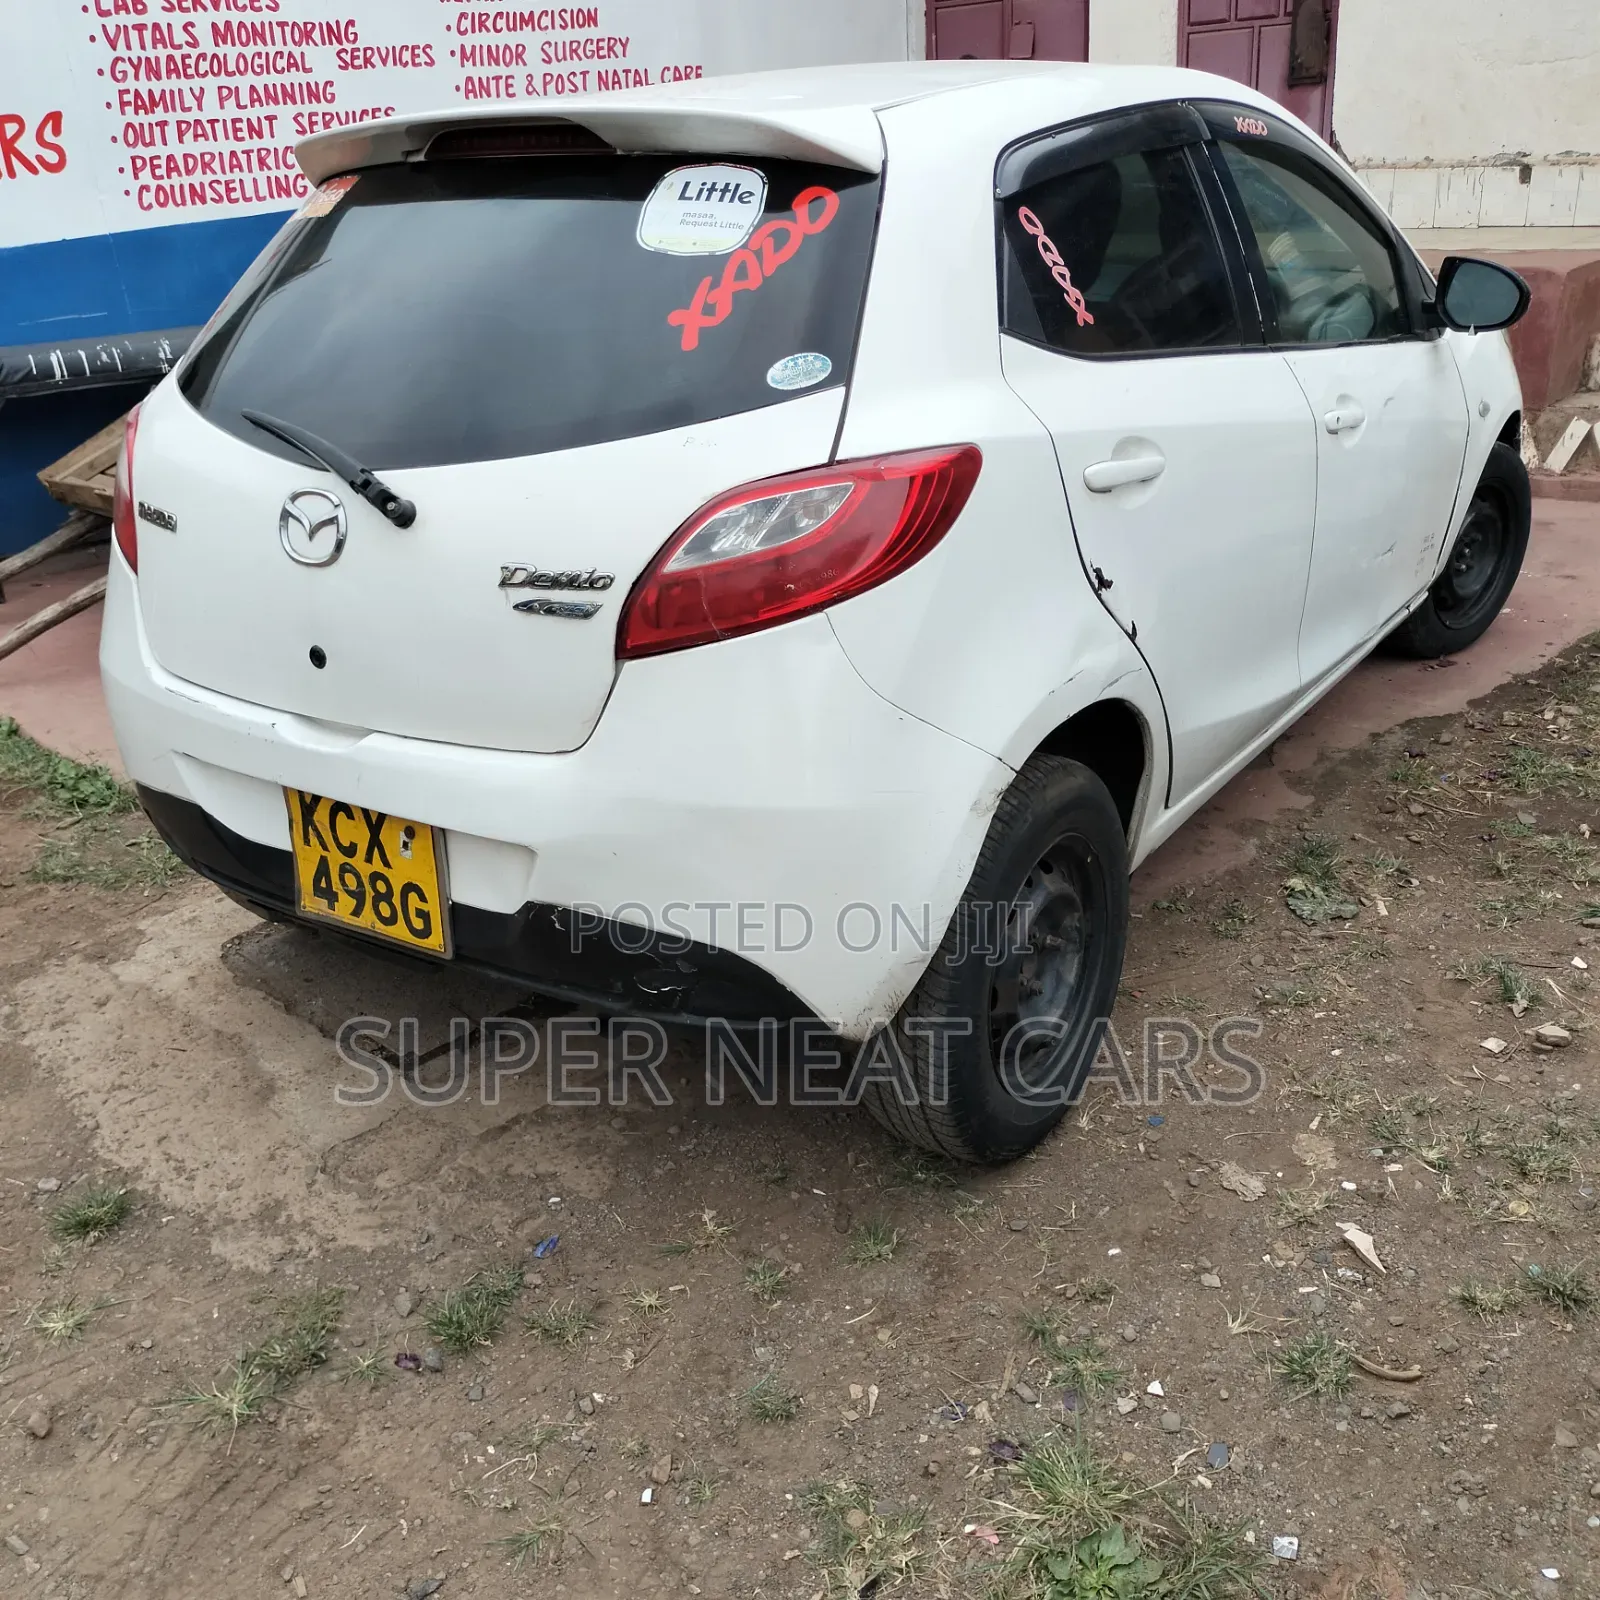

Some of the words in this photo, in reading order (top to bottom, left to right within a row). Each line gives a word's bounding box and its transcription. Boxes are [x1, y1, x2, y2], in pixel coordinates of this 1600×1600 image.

[102, 21, 200, 51] VITALS
[211, 19, 359, 48] MONITORING
[456, 7, 599, 36] CIRCUMCISION
[110, 51, 313, 83] GYNAECOLOGICAL
[337, 44, 436, 71] SERVICES
[460, 43, 527, 67] MINOR
[540, 37, 630, 64] SURGERY
[118, 86, 205, 116] FAMILY
[217, 80, 336, 110] PLANNING
[464, 75, 516, 100] ANTE
[597, 68, 655, 91] NATAL
[660, 65, 703, 84] CARE
[0, 110, 67, 180] RS
[123, 119, 169, 148] OUT
[177, 115, 278, 145] PATIENT
[130, 145, 296, 180] PEADRIATRIC
[138, 173, 309, 211] COUNSELLING
[677, 180, 756, 205] Little
[679, 218, 718, 228] Request
[719, 221, 744, 231] Little
[297, 789, 393, 870] KCX
[312, 854, 433, 940] 498G
